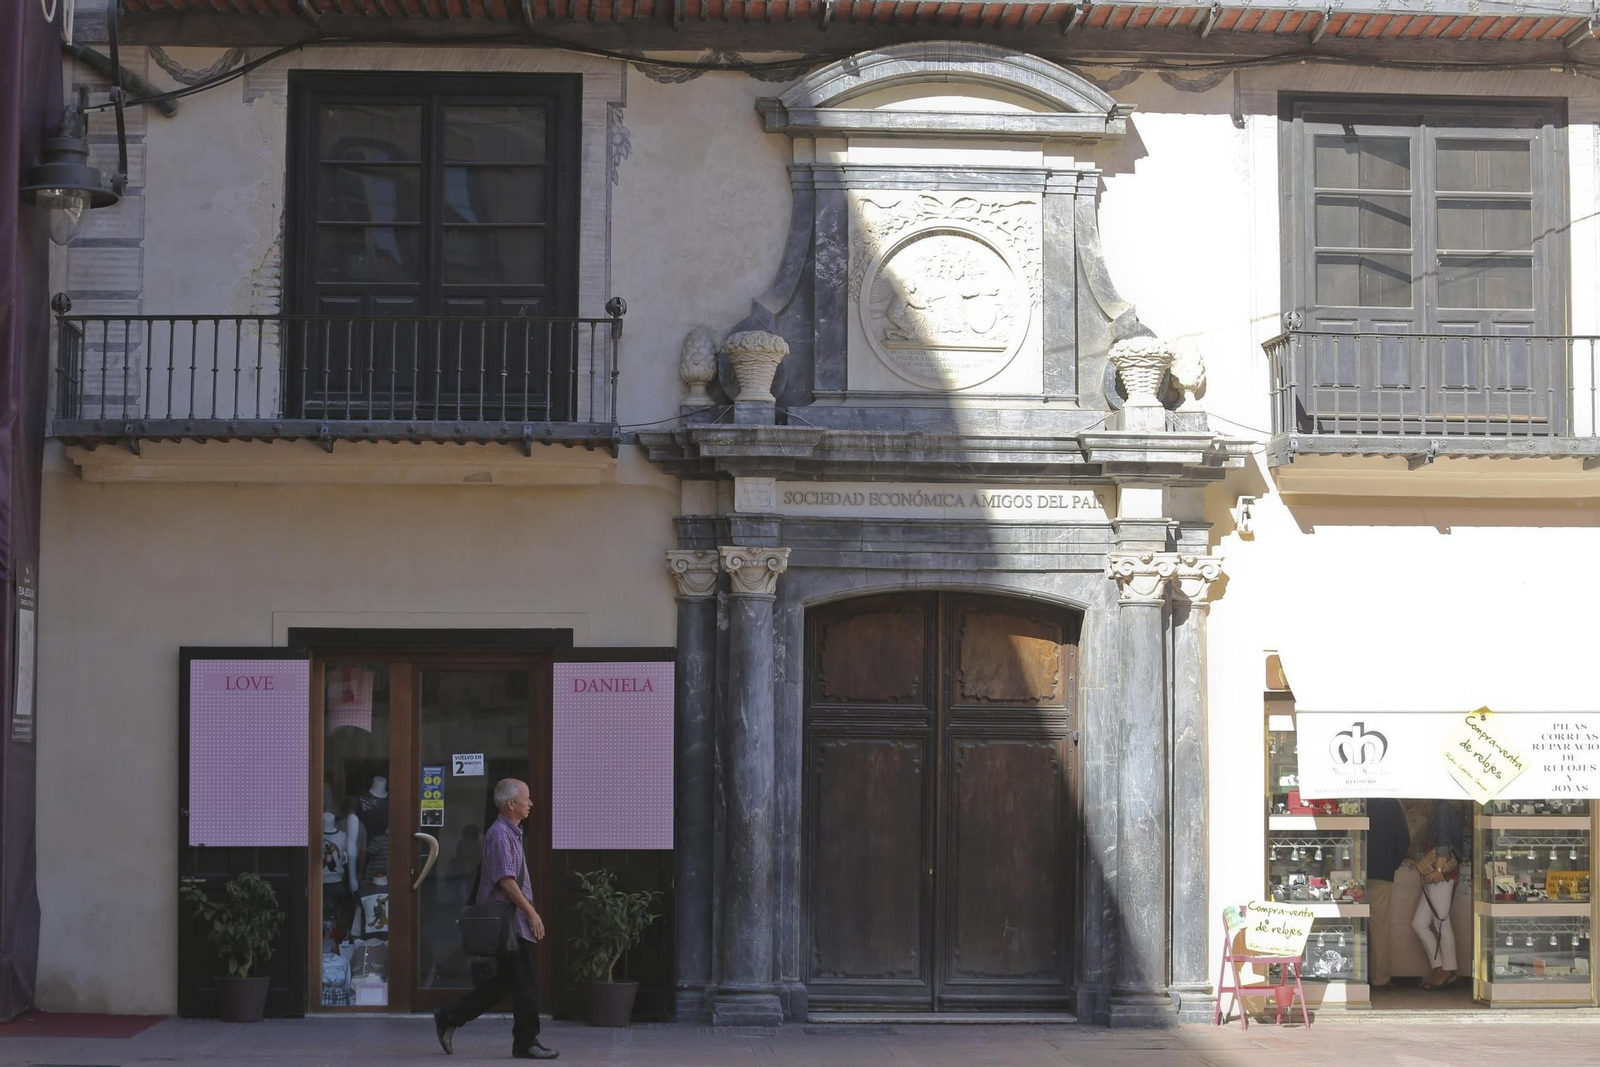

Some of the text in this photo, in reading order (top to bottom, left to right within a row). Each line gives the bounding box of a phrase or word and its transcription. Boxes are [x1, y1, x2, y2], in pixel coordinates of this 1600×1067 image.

[783, 490, 864, 506] SOCIEDAD
[868, 489, 966, 507] ECONÓMICA
[969, 493, 1033, 508] AMIGOS
[1037, 495, 1068, 508] DEL
[225, 676, 275, 690] LOVE
[573, 678, 653, 692] DANIELA
[1465, 715, 1523, 771] Compra-venta
[1541, 733, 1599, 741] CORREAS
[1459, 739, 1473, 753] de
[1473, 753, 1502, 780] relojes
[1562, 754, 1578, 762] DE
[455, 761, 465, 775] 2
[1543, 764, 1597, 772] RELOJES
[1566, 774, 1574, 782] Y
[1551, 784, 1589, 792] JOYAS
[1247, 900, 1315, 918] Compra-venta
[1255, 921, 1303, 940] de relojes
